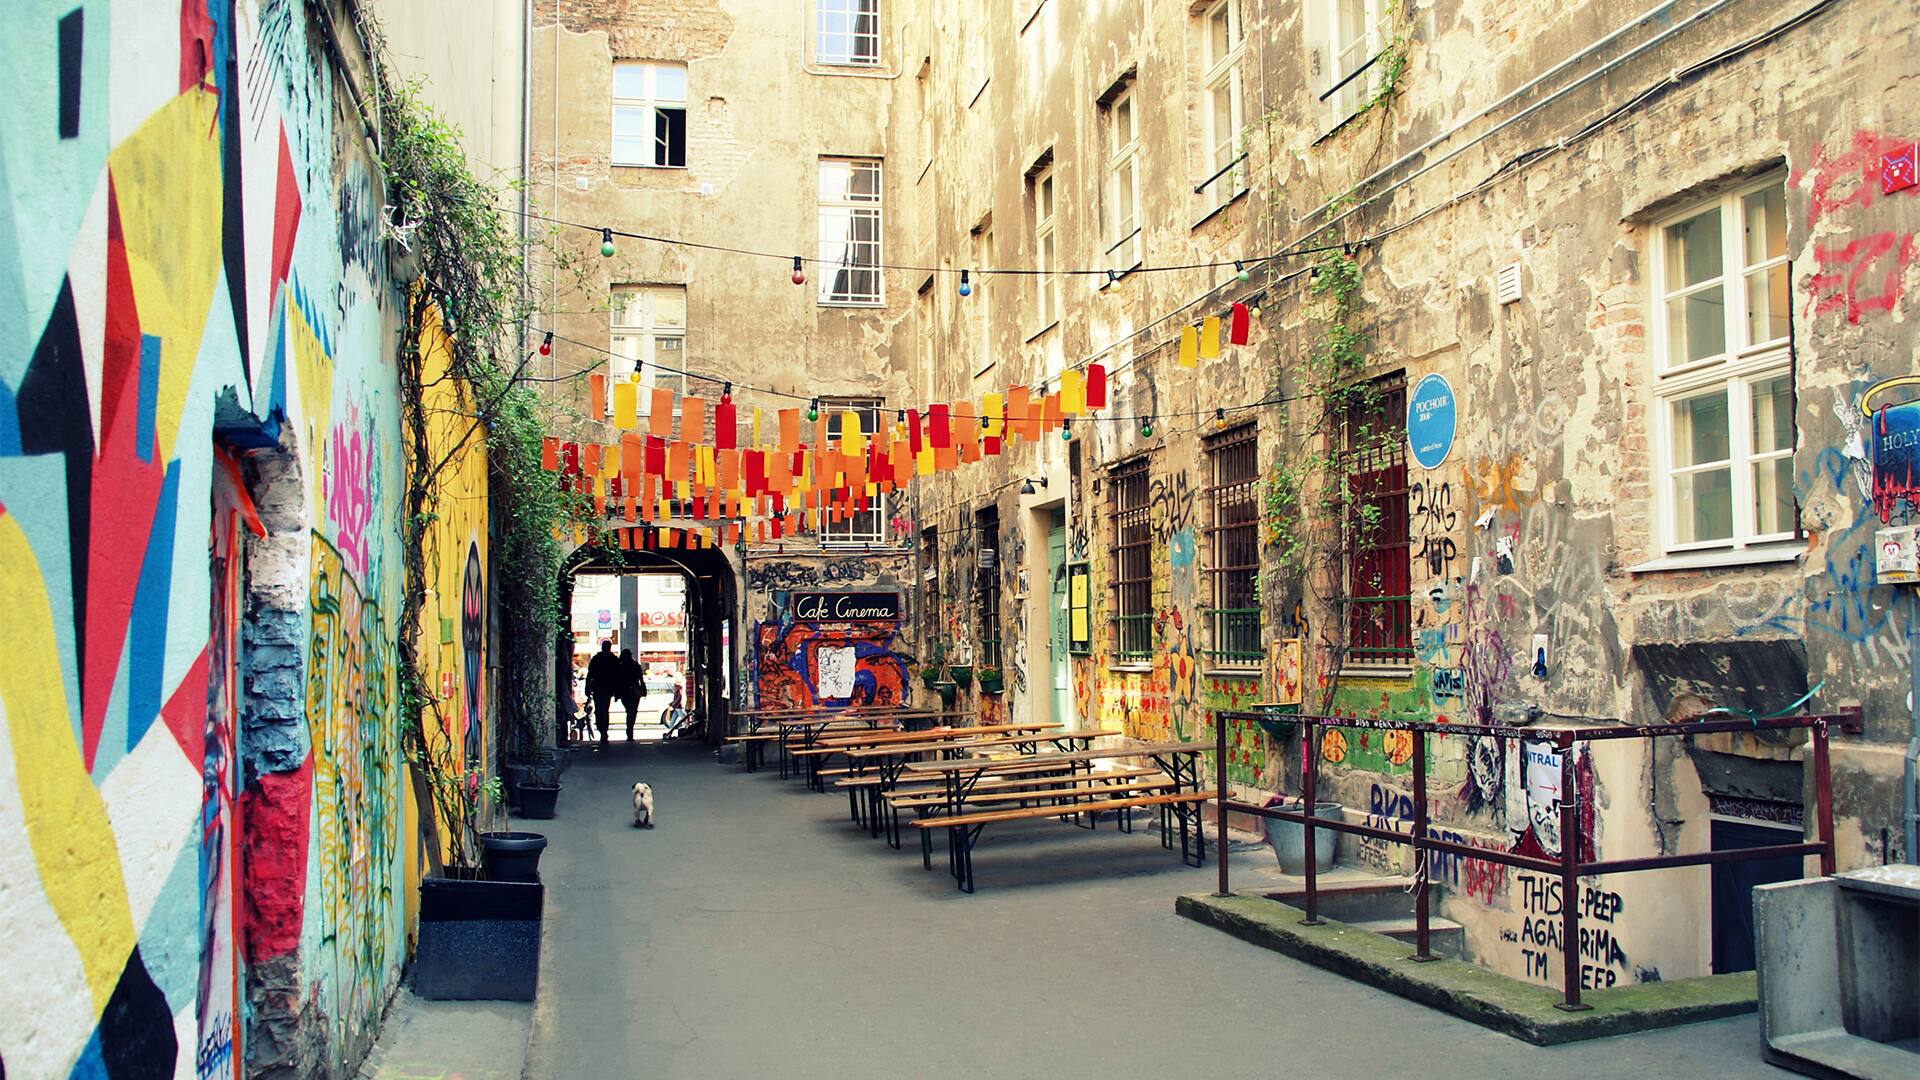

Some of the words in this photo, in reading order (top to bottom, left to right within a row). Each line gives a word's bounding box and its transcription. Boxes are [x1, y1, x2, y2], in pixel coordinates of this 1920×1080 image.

[1882, 428, 1920, 451] HOLY
[797, 596, 830, 621] Café
[835, 595, 895, 619] Cinema
